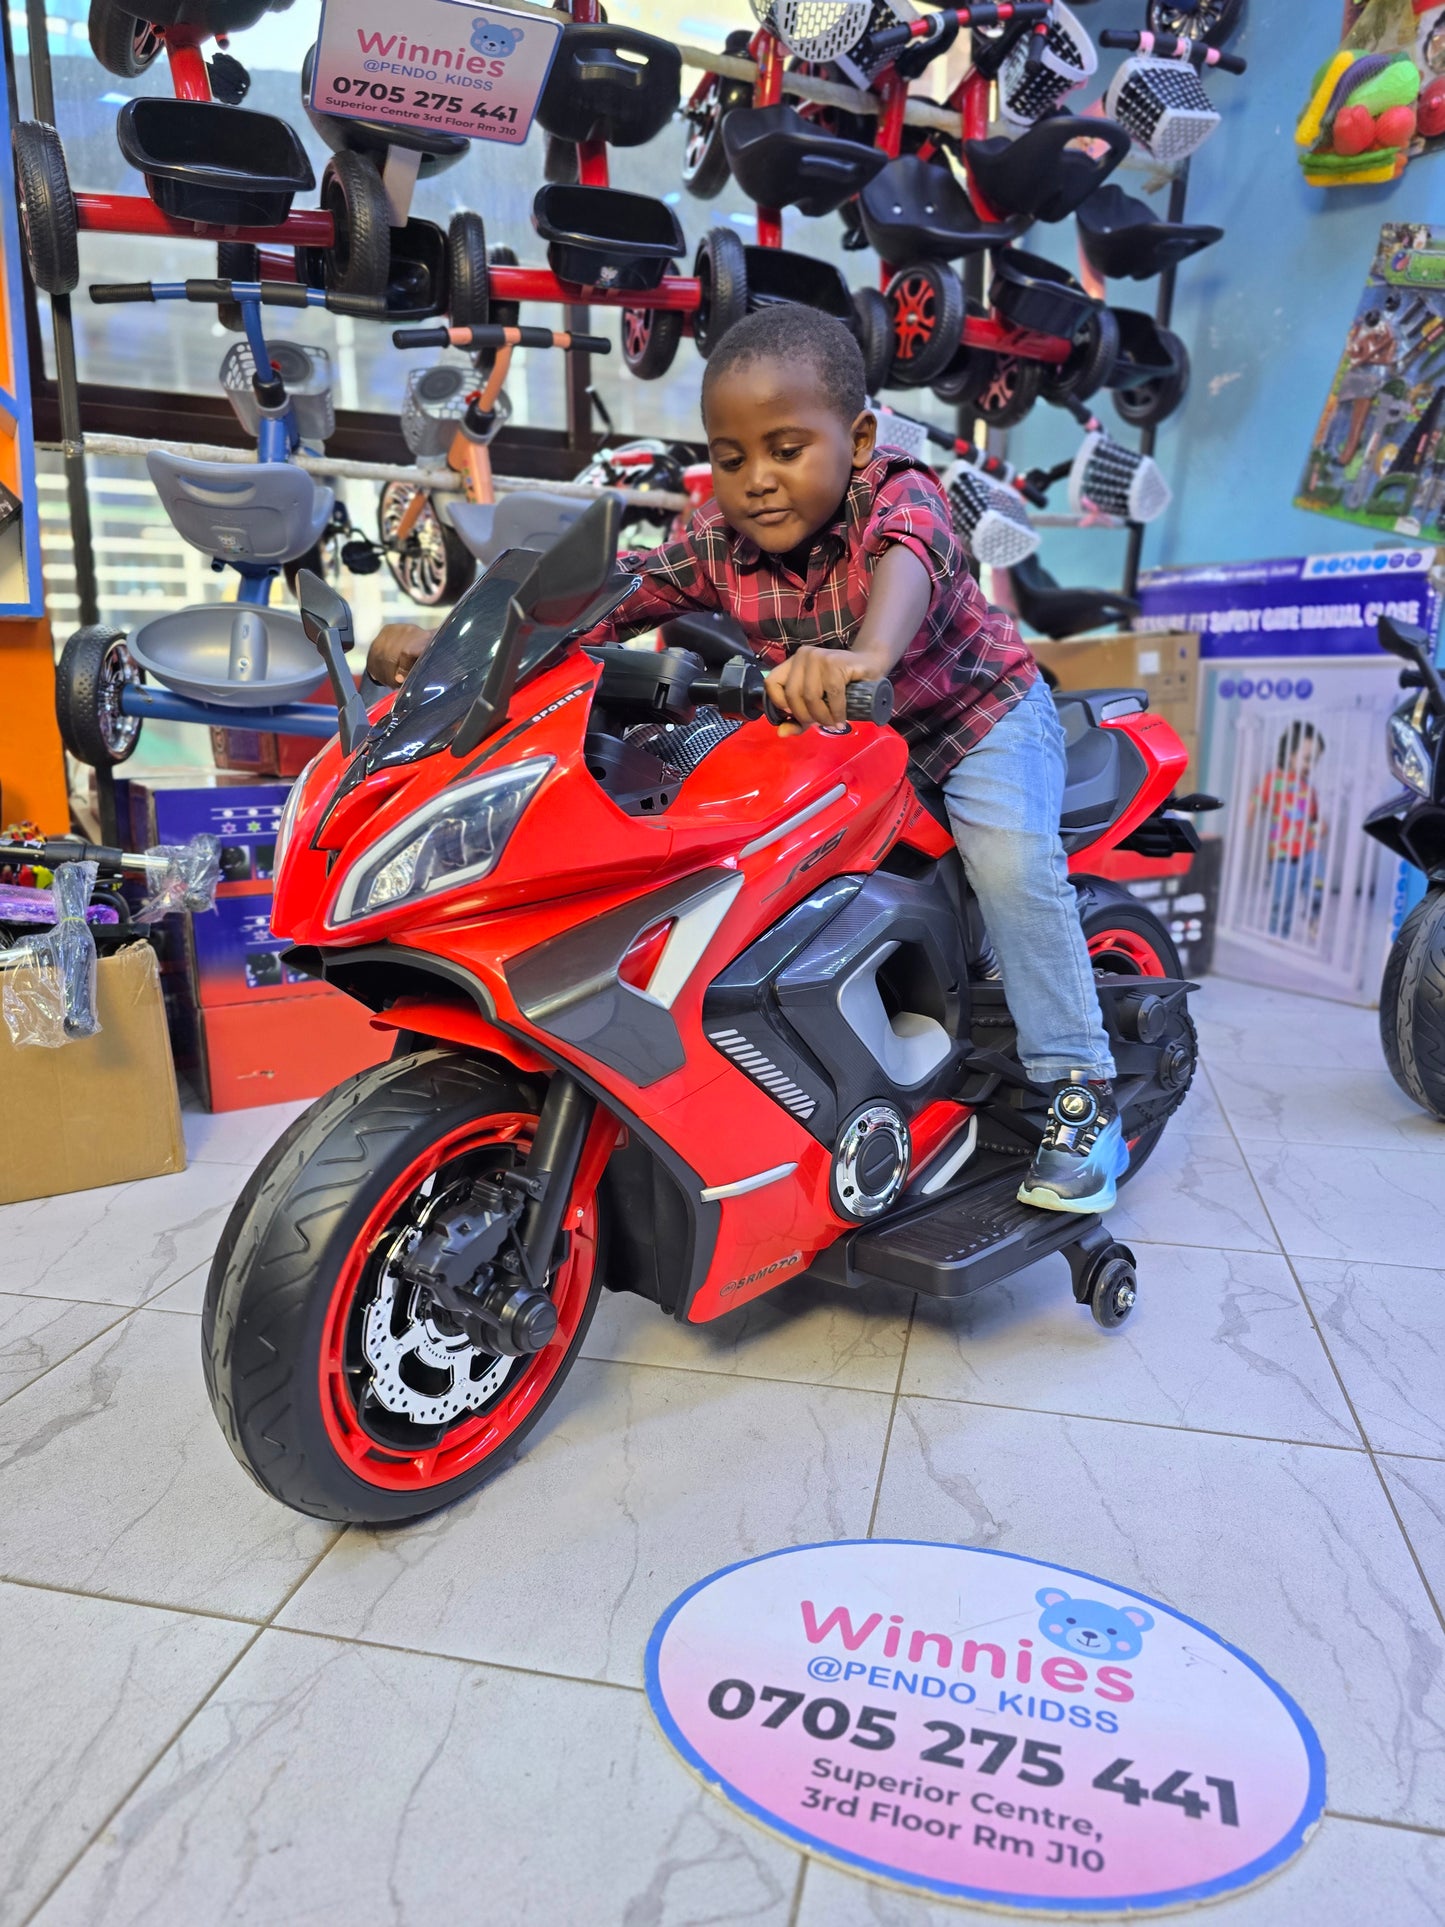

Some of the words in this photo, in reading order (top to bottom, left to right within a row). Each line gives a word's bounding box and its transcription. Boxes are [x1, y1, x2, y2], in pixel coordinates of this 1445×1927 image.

[357, 28, 505, 78] Winnies
[363, 60, 494, 91] @PENDO_KIDSS
[325, 97, 377, 113] Superior
[380, 106, 420, 120] Centre
[423, 113, 442, 123] 3rd
[445, 117, 475, 129] Floor
[477, 124, 496, 133] Rm
[498, 126, 517, 136] J10
[333, 76, 405, 104] 0705
[412, 90, 463, 113] 275
[470, 102, 518, 123] 441
[737, 1256, 798, 1289] SRMOTO
[800, 1599, 1136, 1704] Winnies
[806, 1655, 1120, 1734] @PENDO_KIDSS
[707, 1678, 898, 1751] 0705
[919, 1719, 1065, 1787] 275
[1092, 1758, 1240, 1828] 441
[801, 1786, 859, 1819] 3rd
[870, 1800, 963, 1841] Floor
[973, 1830, 1035, 1859] Rm
[1046, 1841, 1106, 1874] J10
[811, 1756, 960, 1807] Superior
[970, 1792, 1103, 1843] Centre,
